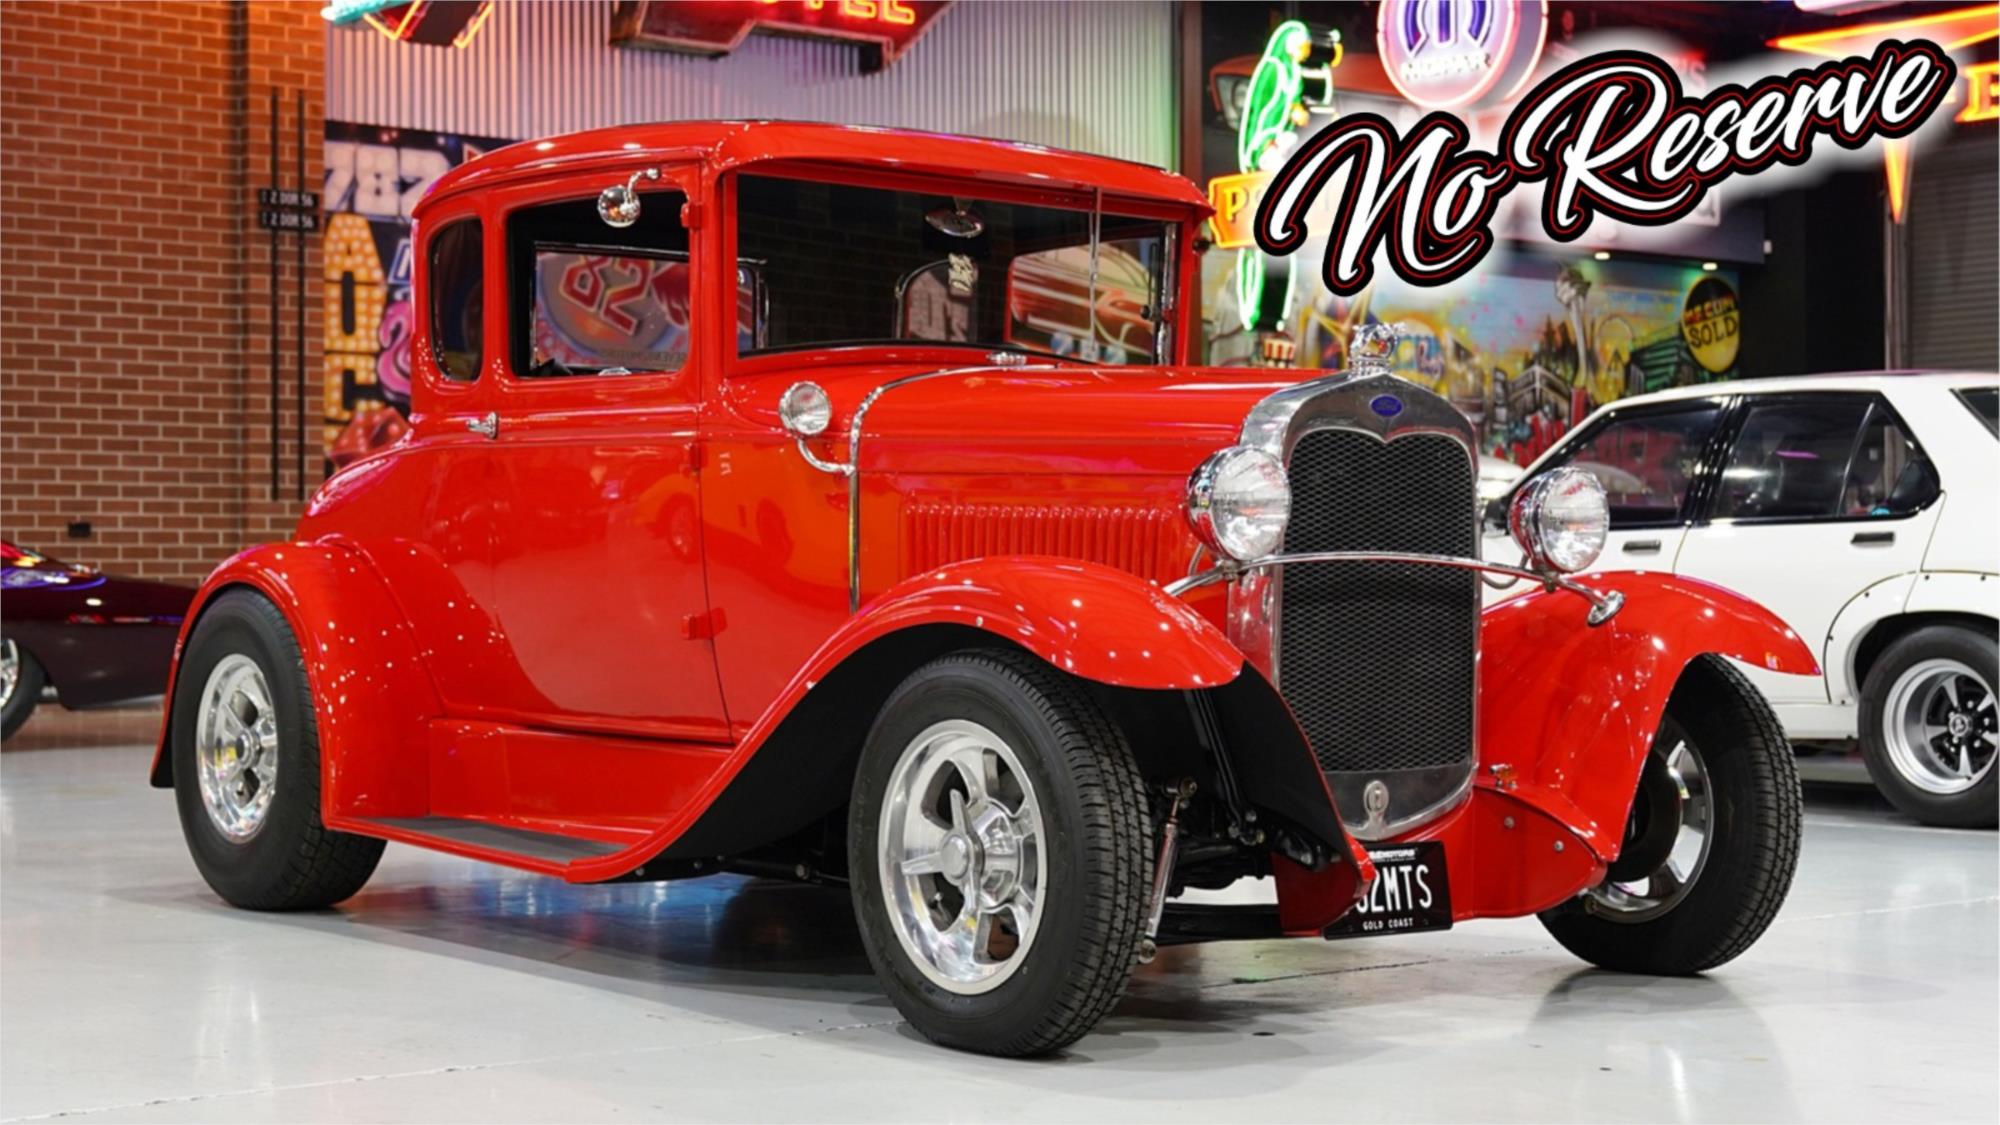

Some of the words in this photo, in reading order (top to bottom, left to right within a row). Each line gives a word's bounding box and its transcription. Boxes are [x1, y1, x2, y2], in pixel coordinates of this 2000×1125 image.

[1400, 52, 1491, 82] MOPAR
[1688, 315, 1738, 348] SOLD
[1362, 919, 1384, 931] GOLD
[1387, 917, 1414, 928] COAST
